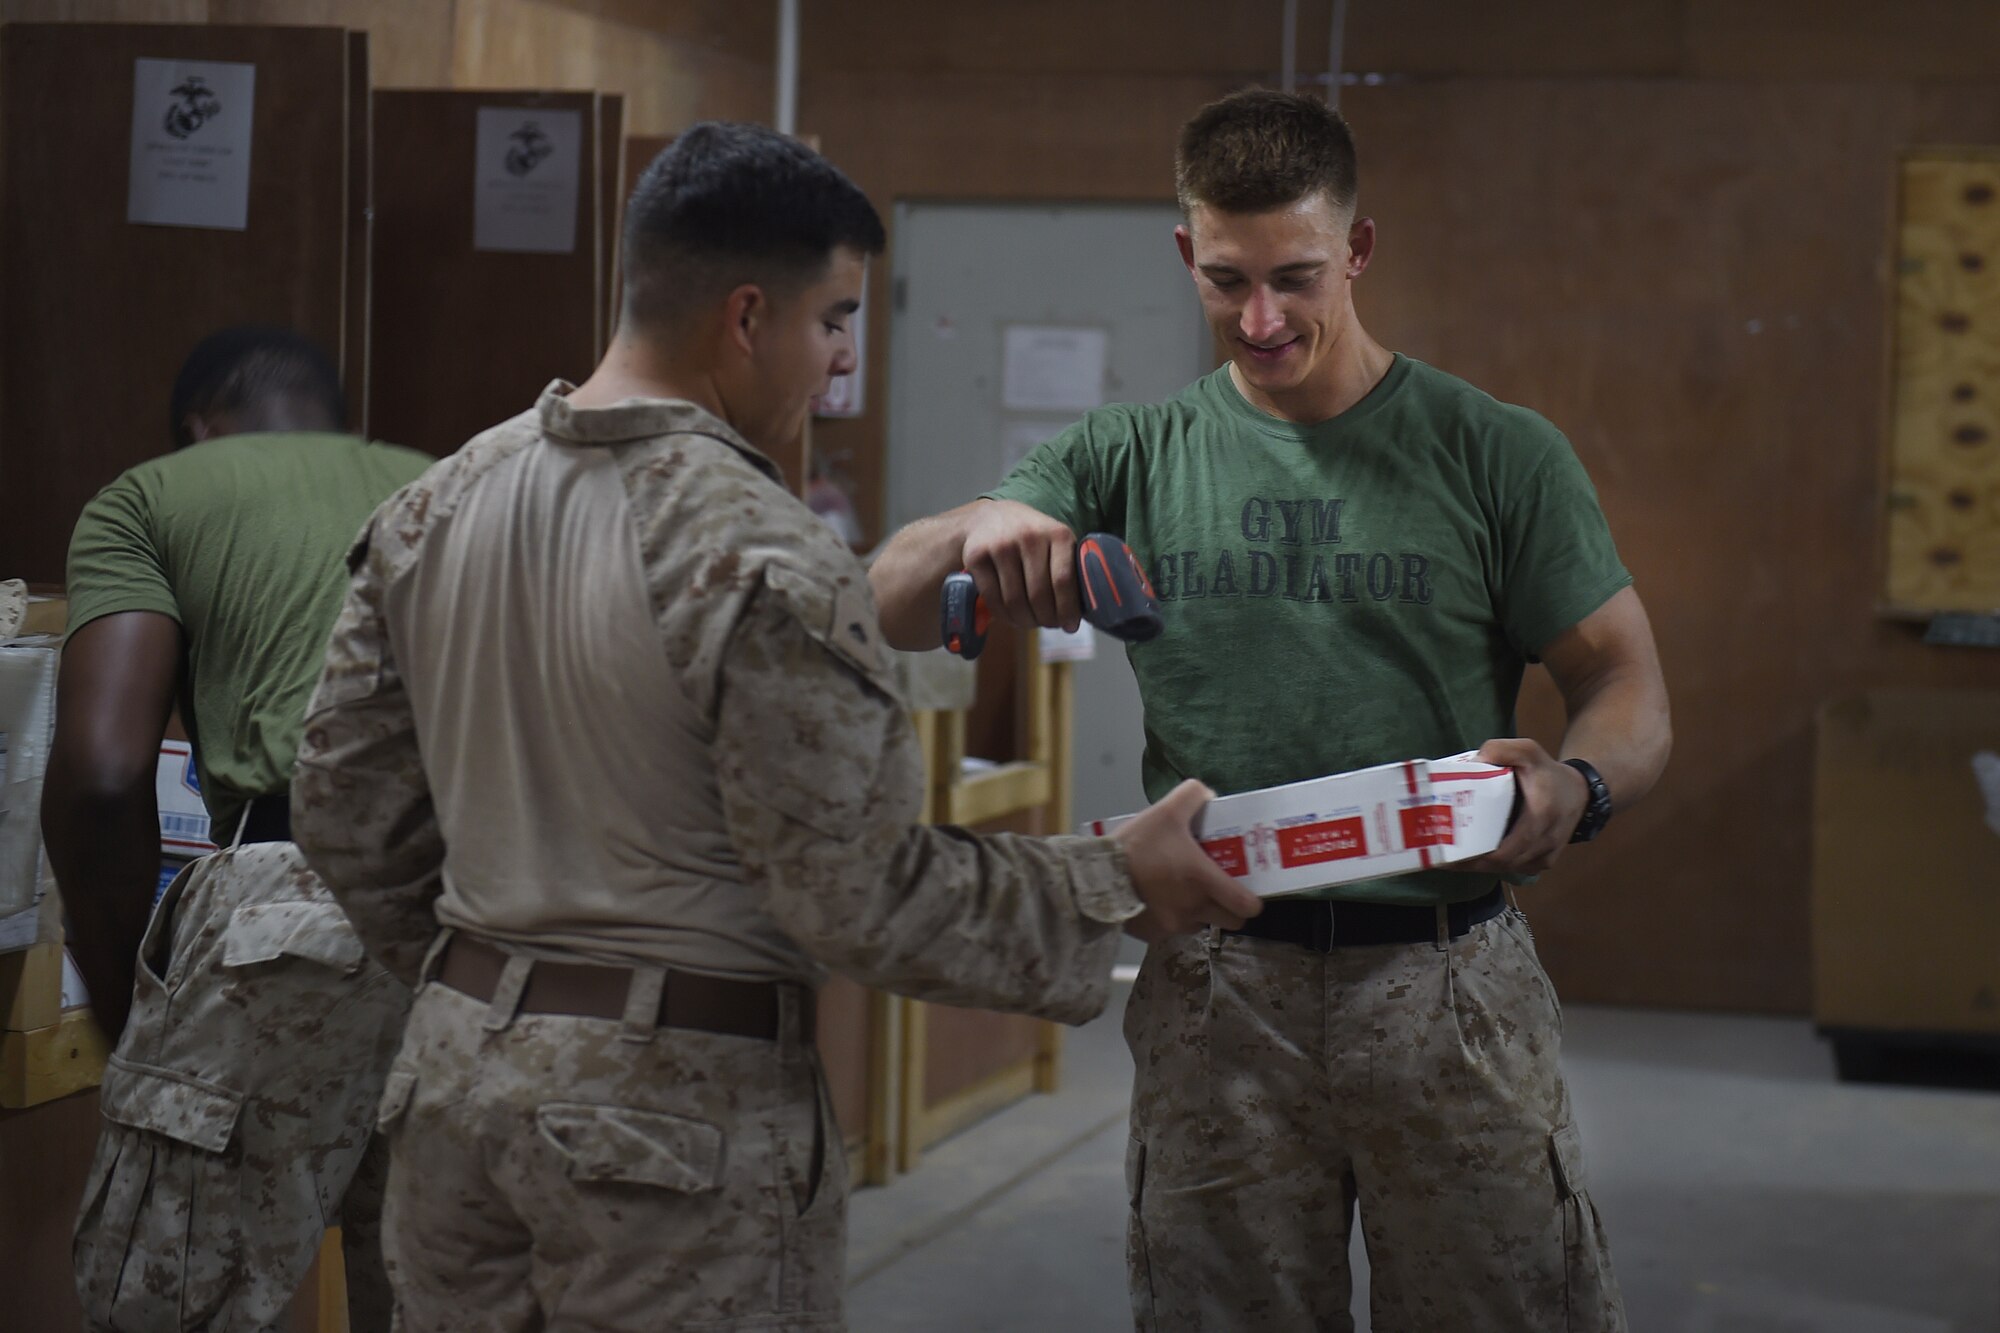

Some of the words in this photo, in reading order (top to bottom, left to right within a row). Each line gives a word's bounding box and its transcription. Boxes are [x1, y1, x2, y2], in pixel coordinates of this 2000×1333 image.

[1240, 497, 1345, 546] GYM
[1156, 549, 1434, 604] GLADIATOR
[1291, 838, 1358, 857] PRIORITY
